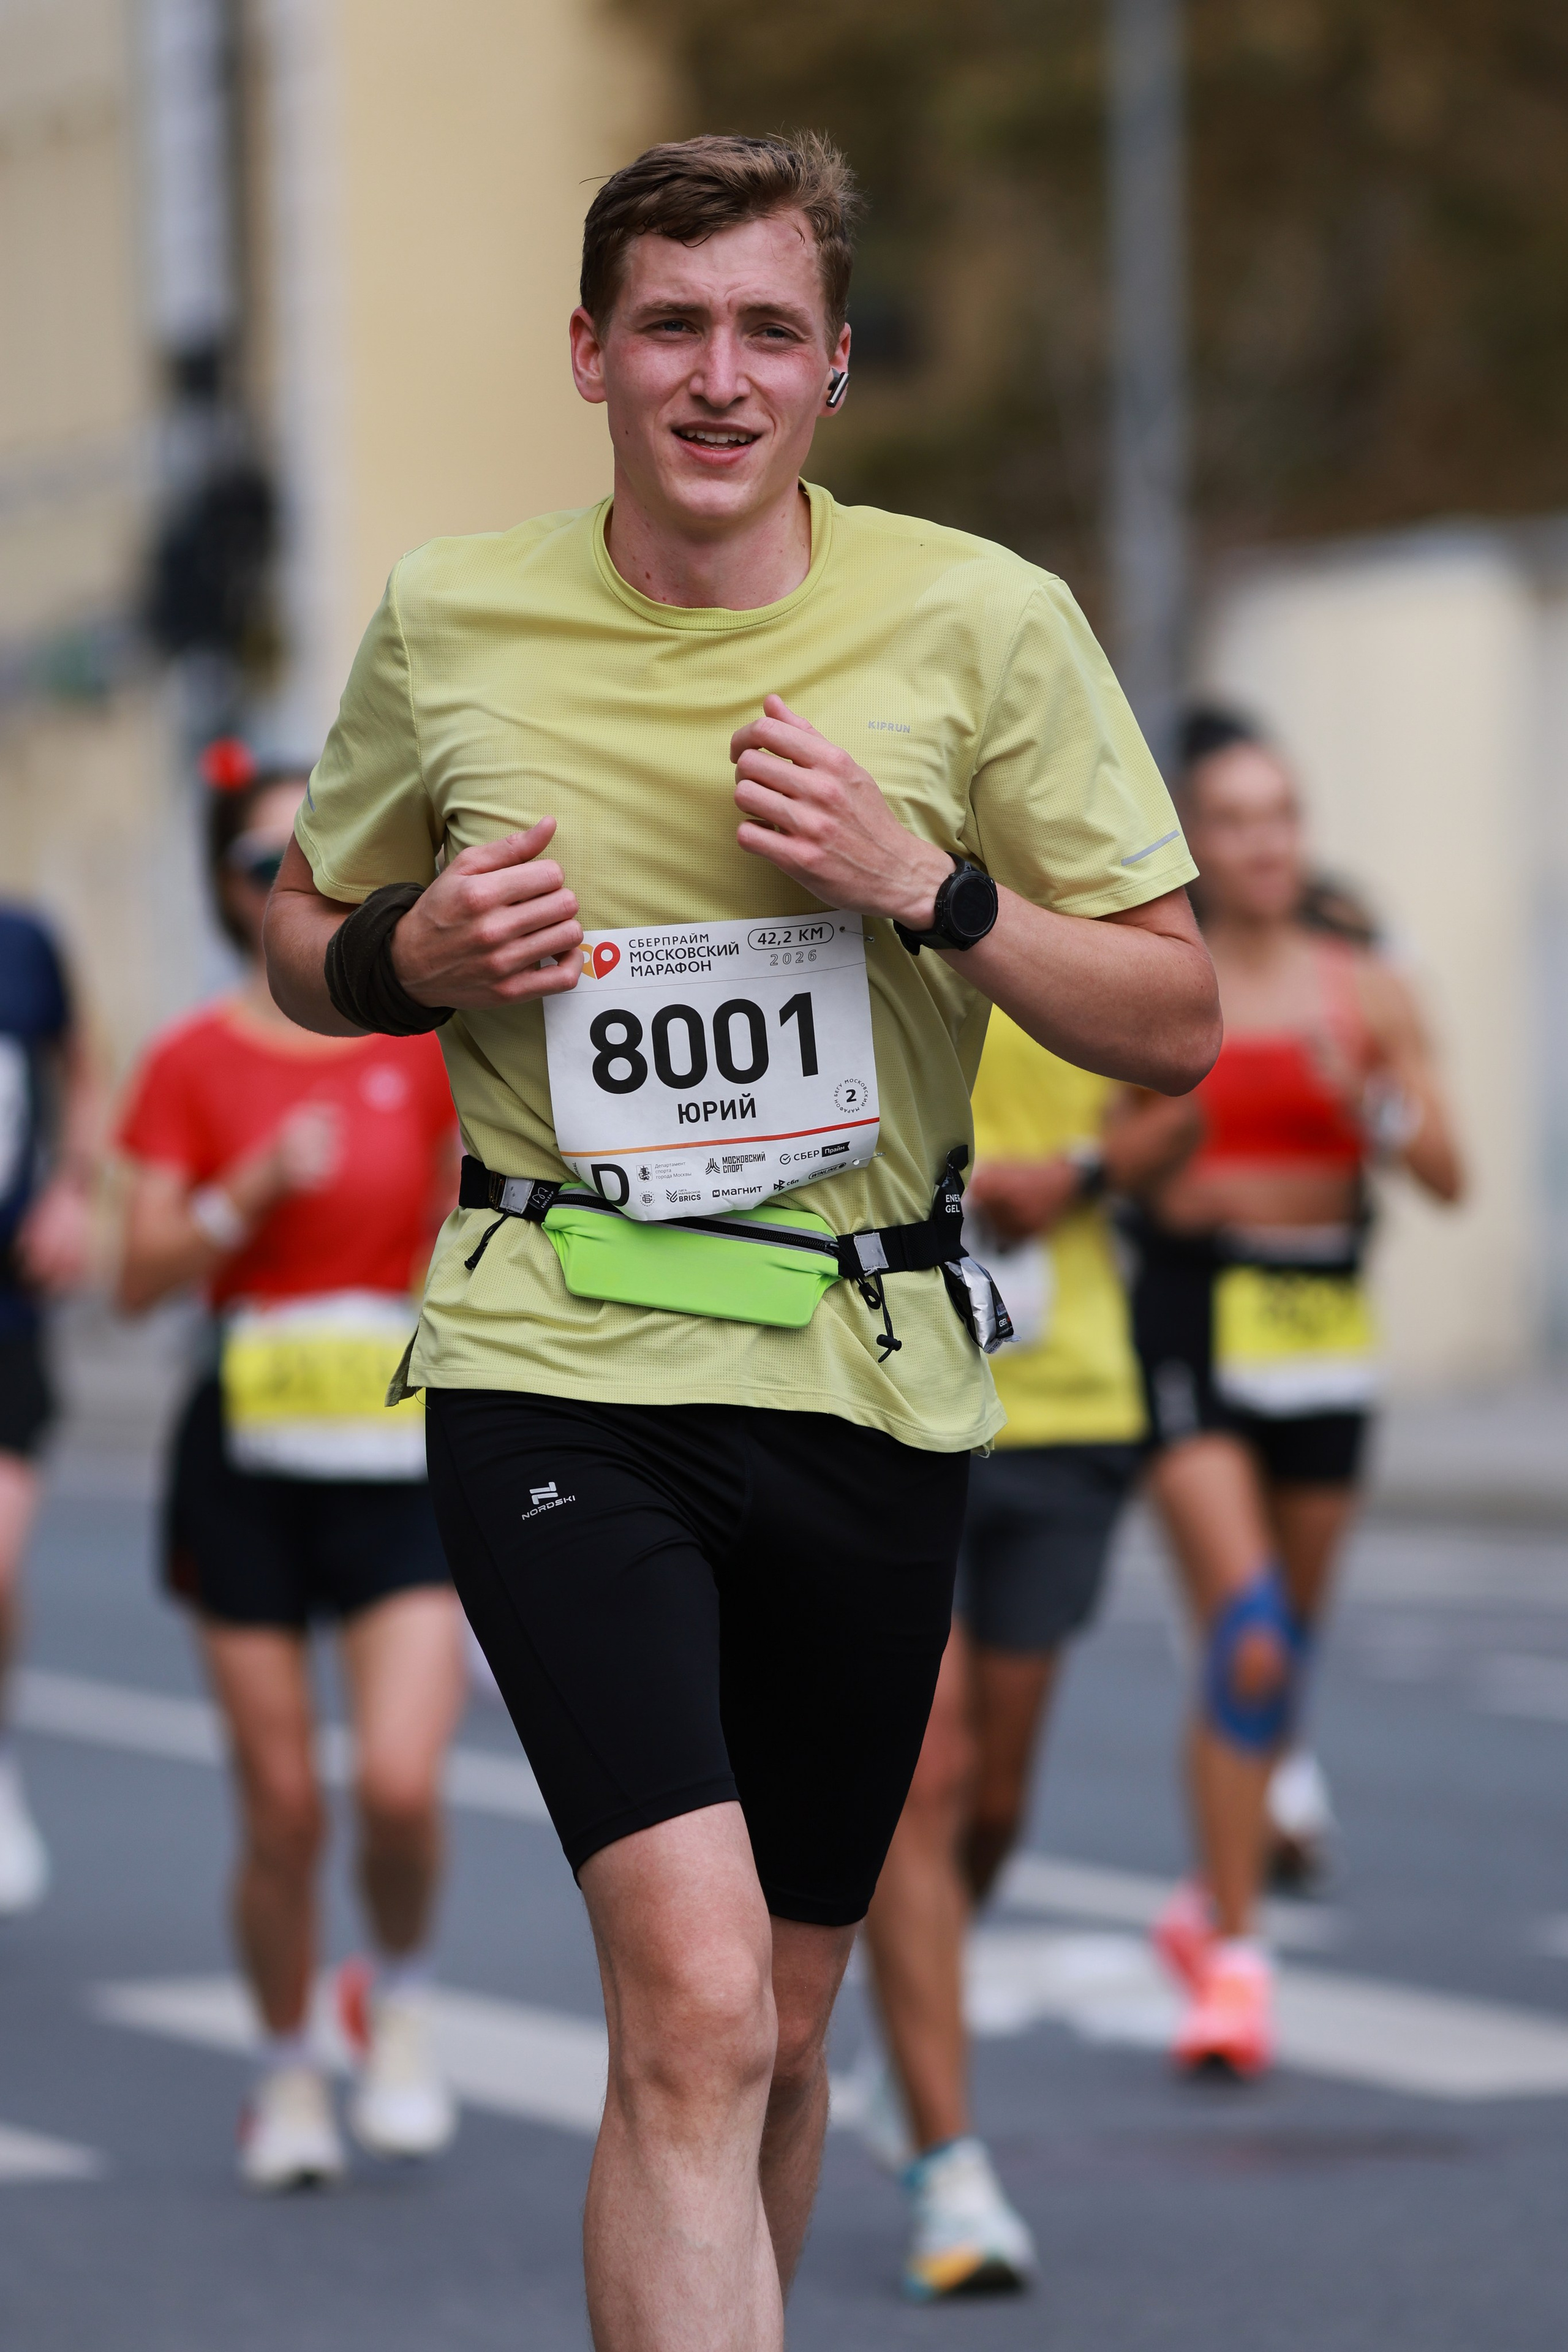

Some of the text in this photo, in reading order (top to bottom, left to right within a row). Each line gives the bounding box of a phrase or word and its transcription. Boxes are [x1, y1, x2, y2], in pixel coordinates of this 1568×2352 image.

[868, 720, 910, 733] KIPRUN
[628, 933, 709, 949] СБЕРПРАЙМ
[757, 926, 824, 946] 42,2 КМ
[629, 941, 740, 963] МОСКОВСКИЙ
[769, 949, 817, 966] 2026
[631, 960, 712, 978] МАРАФОН
[589, 992, 819, 1095] 8001
[846, 1089, 857, 1102] 2
[677, 1093, 757, 1125] ЮРИЙ
[722, 1152, 766, 1165] МОСКОВСКИЙ
[794, 1145, 845, 1161] СБЕР Прайм
[723, 1164, 744, 1174] СПОРТ
[812, 1166, 839, 1178] WINLINE
[590, 1163, 630, 1207] D
[945, 1204, 960, 1213] GEL
[521, 1495, 576, 1520] NORDSKI
